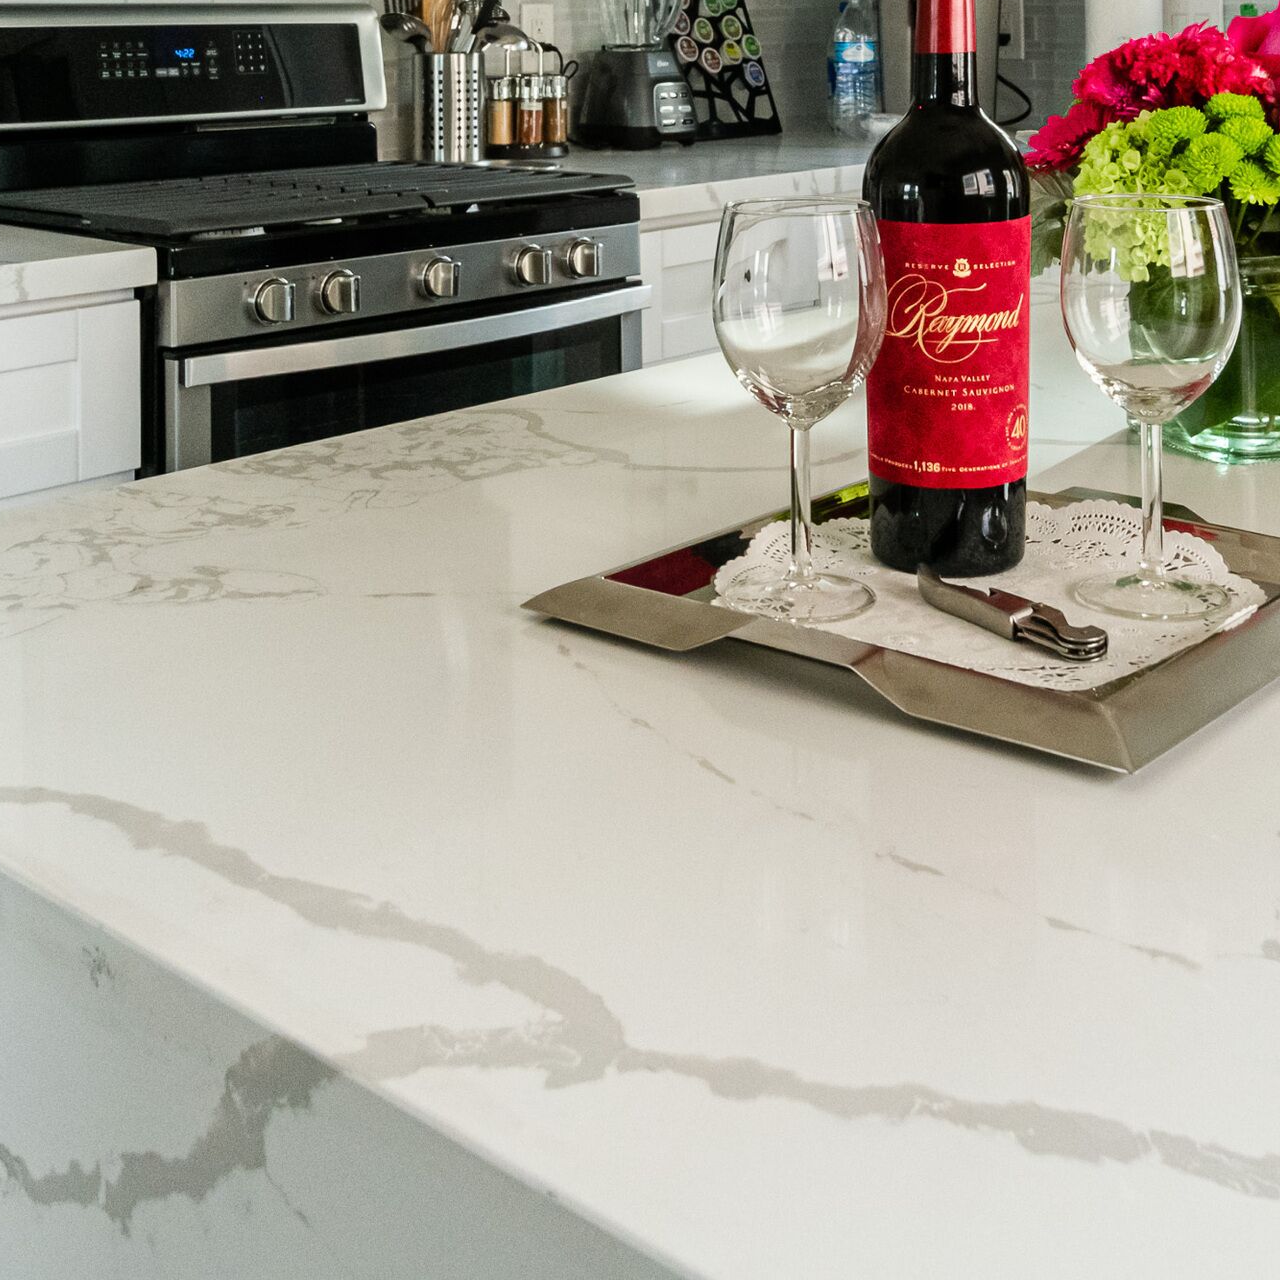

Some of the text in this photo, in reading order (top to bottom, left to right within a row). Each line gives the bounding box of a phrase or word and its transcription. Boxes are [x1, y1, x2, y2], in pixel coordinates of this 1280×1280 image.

[175, 48, 195, 58] 4:22
[904, 260, 1016, 270] RESERVE SELECTION
[886, 273, 1024, 363] Raymond
[934, 374, 990, 383] NAPA VALLEY
[904, 384, 1015, 397] CABERNET SAUVIGNON
[1011, 415, 1026, 439] 40
[914, 460, 941, 473] 1,136
